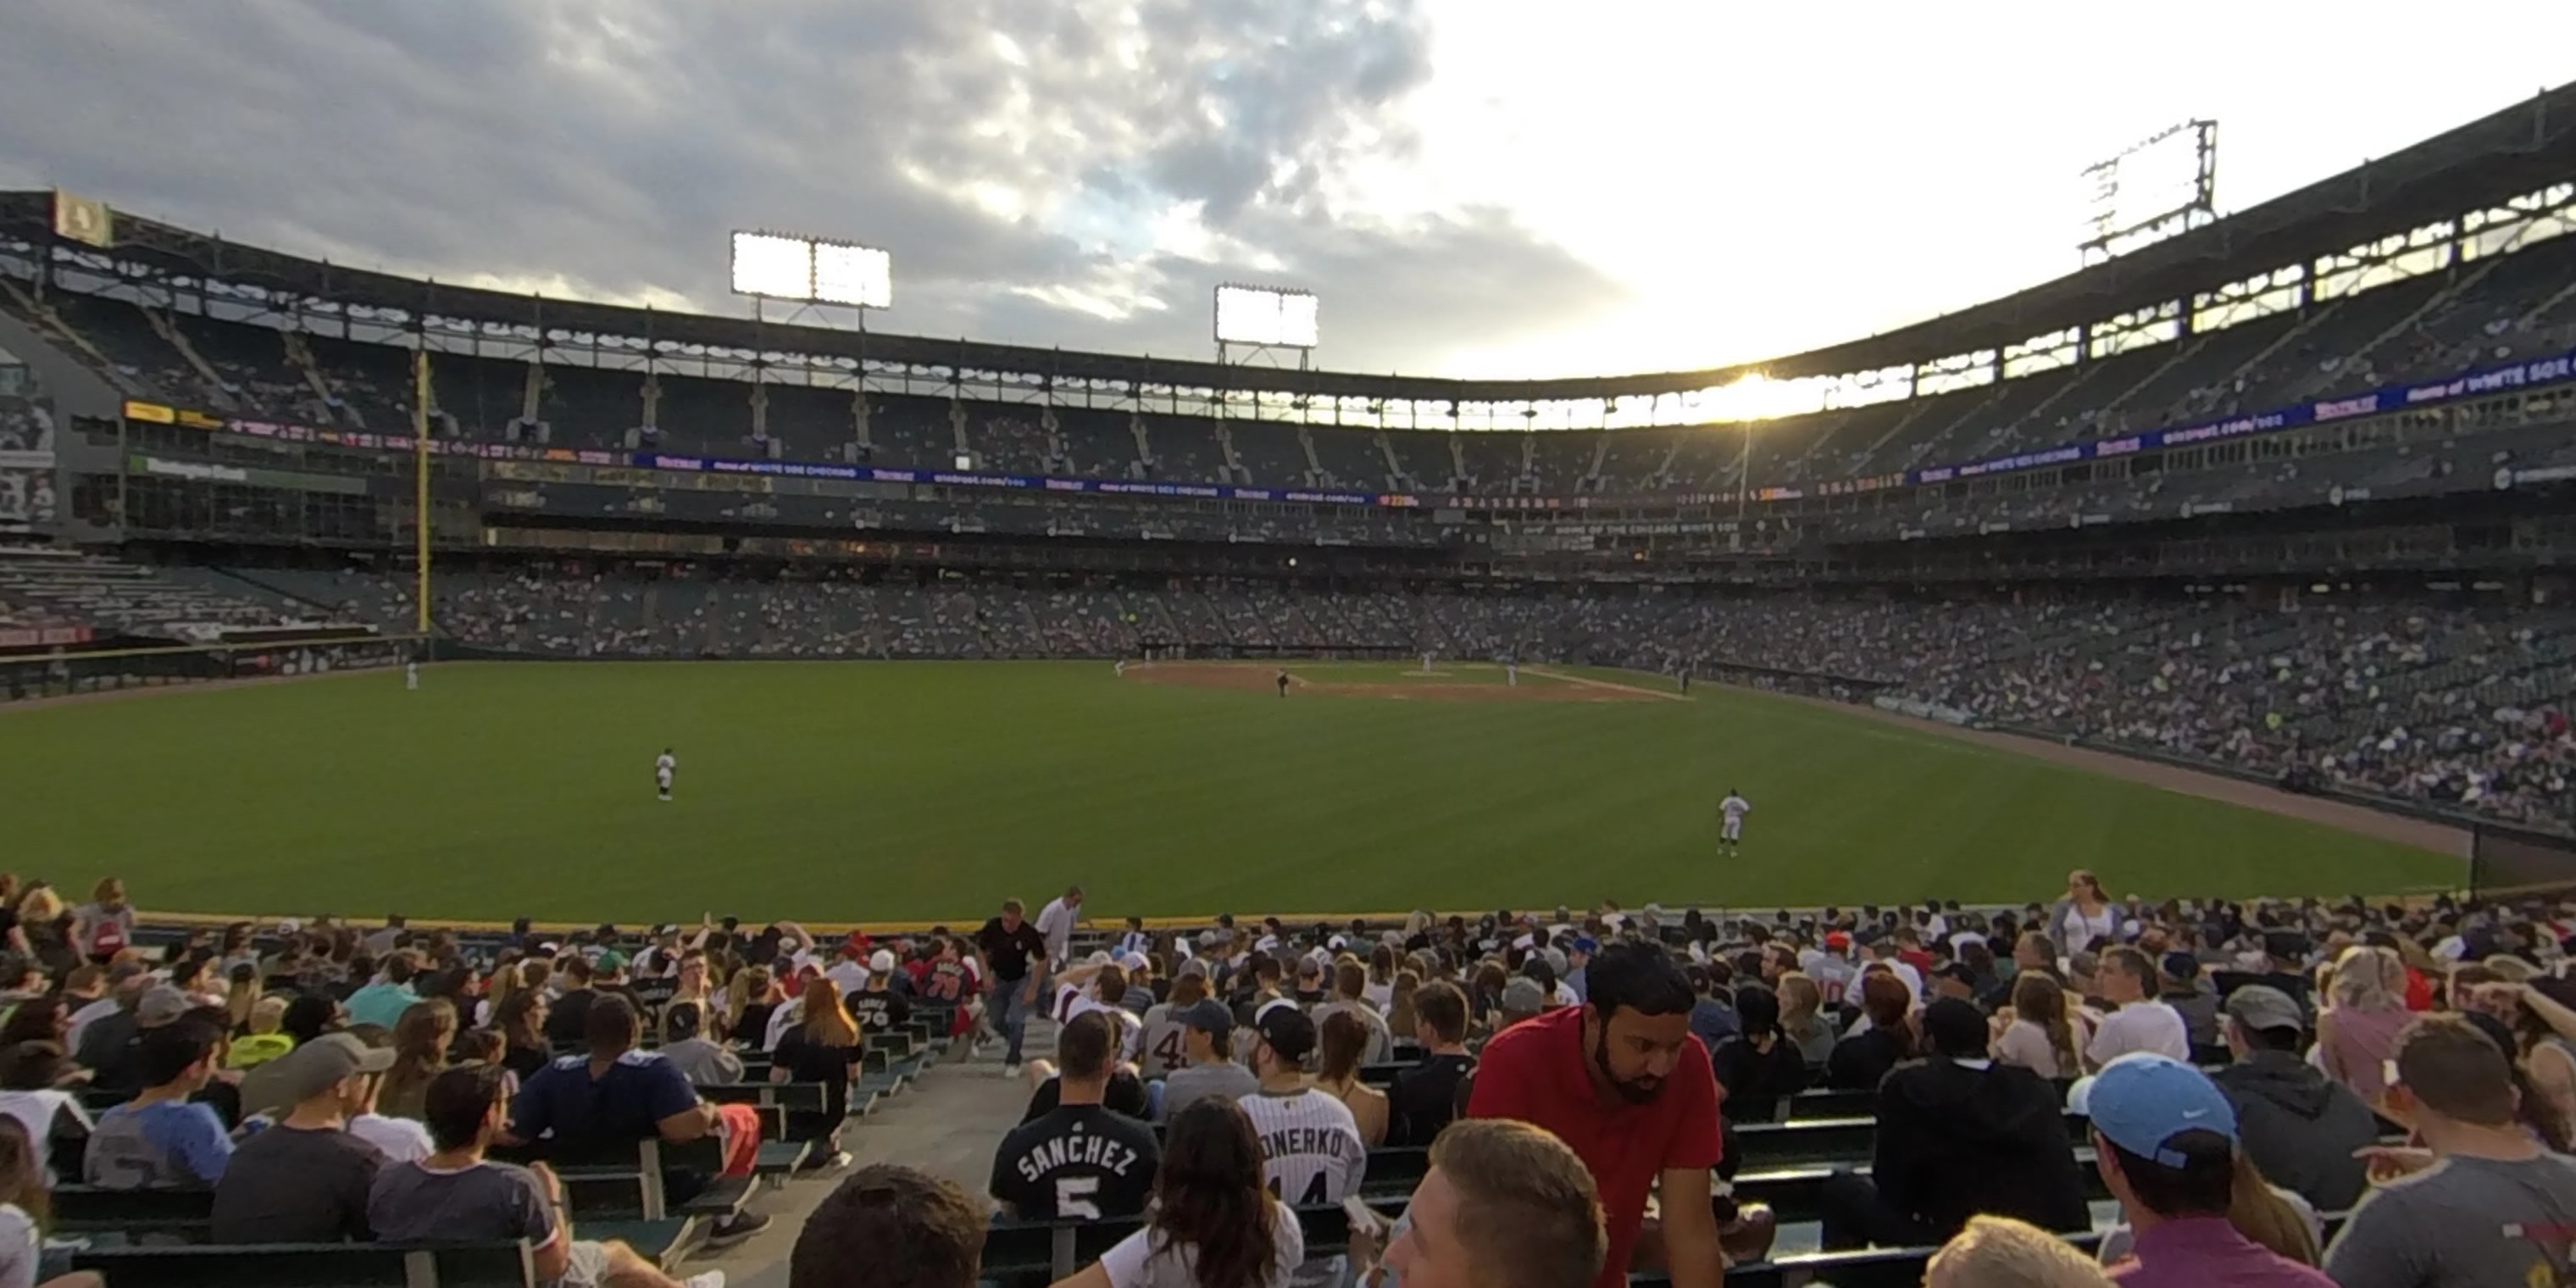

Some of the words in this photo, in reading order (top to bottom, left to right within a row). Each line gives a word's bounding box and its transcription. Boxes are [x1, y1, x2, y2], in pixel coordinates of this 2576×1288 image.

[1017, 1135, 1138, 1182] SANCHEZ
[1258, 1127, 1344, 1160] ONERKO
[1055, 1176, 1102, 1219] 5
